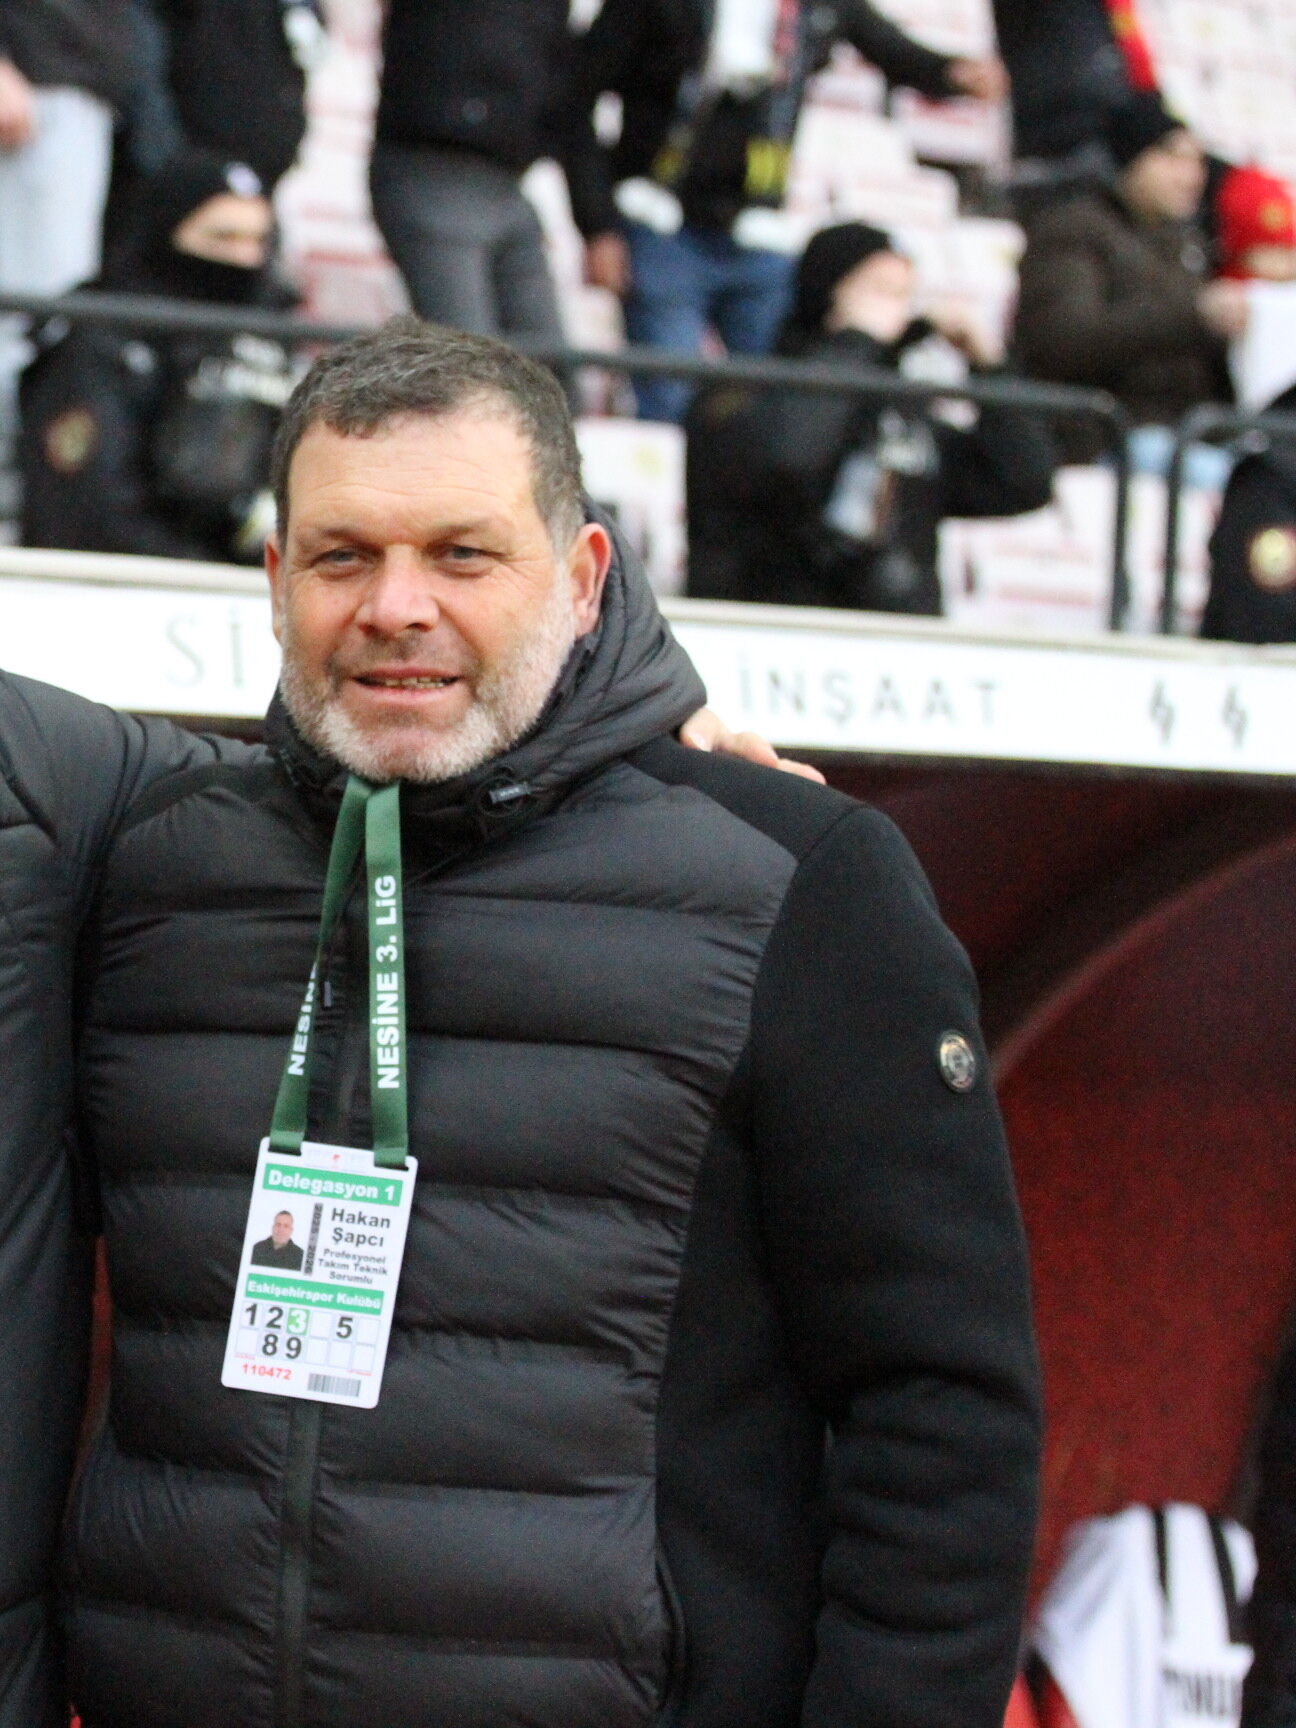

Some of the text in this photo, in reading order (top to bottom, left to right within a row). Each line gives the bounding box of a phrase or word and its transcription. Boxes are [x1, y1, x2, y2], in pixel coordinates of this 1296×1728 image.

[738, 652, 1000, 728] İNŞAAT
[372, 874, 400, 1089] NESİNE 3. LİG
[268, 1169, 395, 1201] Delegasyon 1
[331, 1207, 390, 1228] Hakan
[332, 1227, 384, 1247] Şapcı
[318, 1258, 388, 1276] Takım Teknik
[323, 1248, 386, 1264] Profesyonel
[329, 1270, 373, 1285] Sorumlu
[247, 1280, 333, 1303] Eskişehirspor
[245, 1303, 353, 1339] 1 2 3 5
[262, 1334, 302, 1359] 8 9
[242, 1363, 292, 1380] 110472
